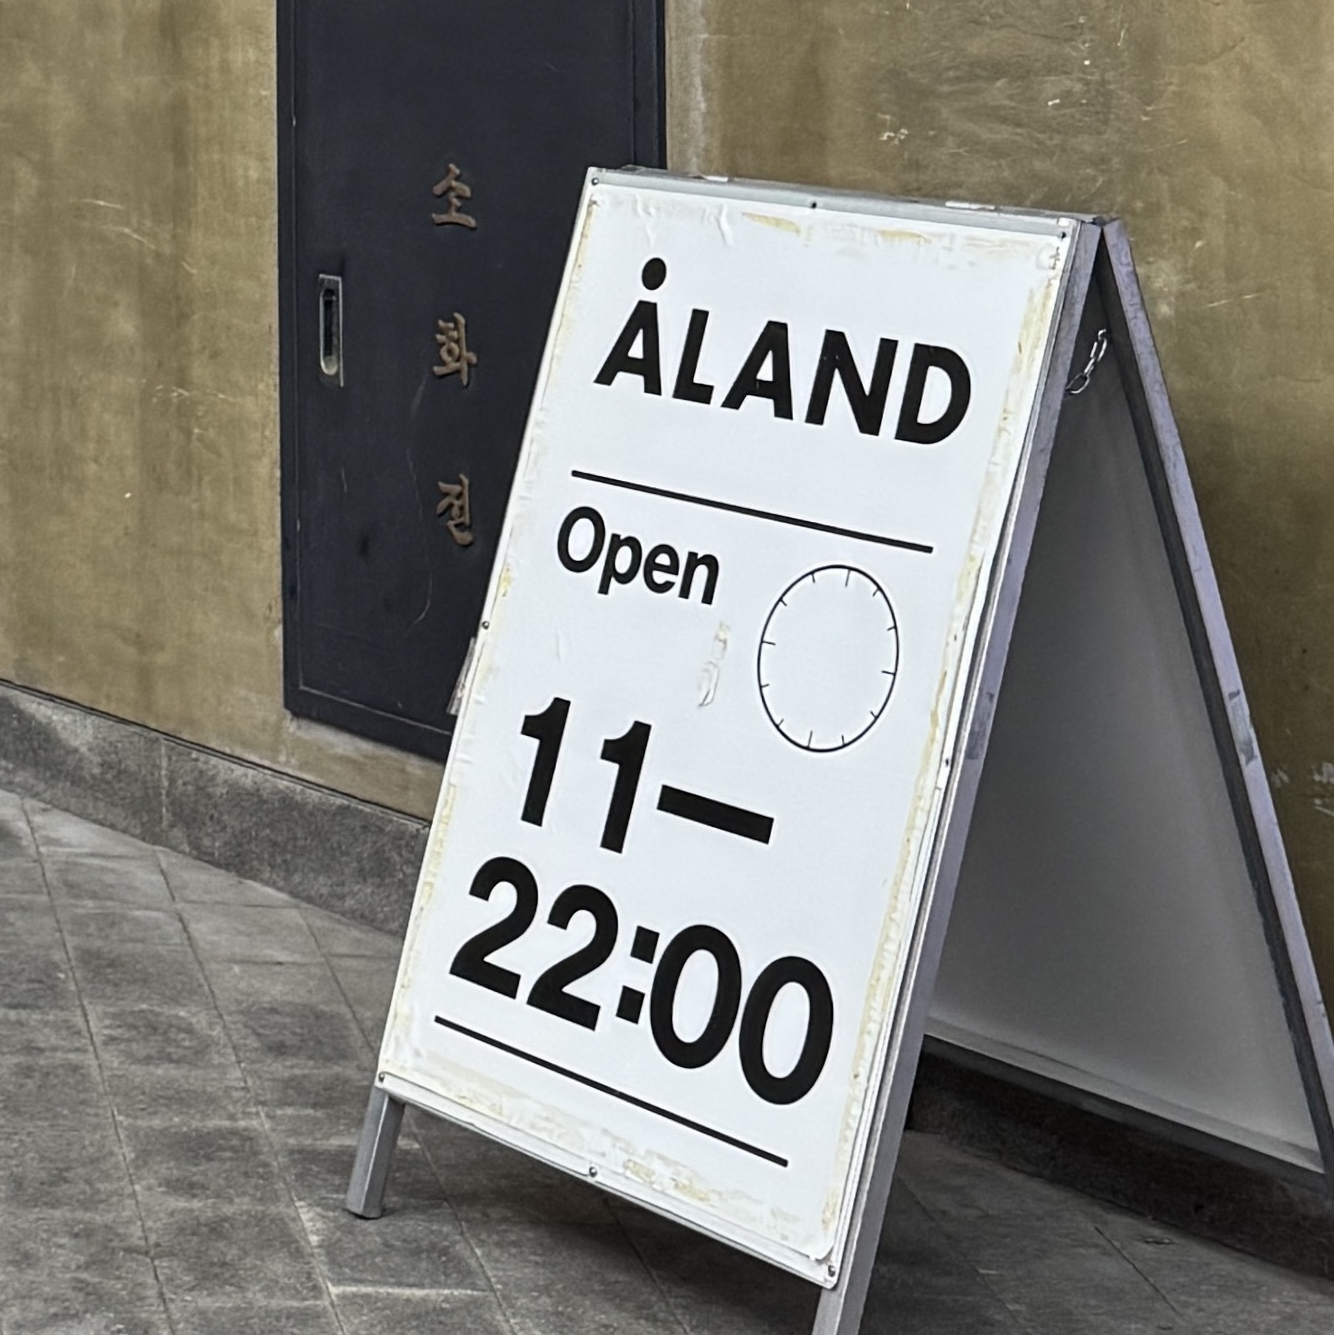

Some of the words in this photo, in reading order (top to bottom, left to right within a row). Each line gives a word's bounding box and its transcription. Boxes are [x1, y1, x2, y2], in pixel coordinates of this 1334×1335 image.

[593, 257, 972, 445] ÅLAND
[556, 506, 721, 605] Open
[448, 856, 835, 1105] 22:00
